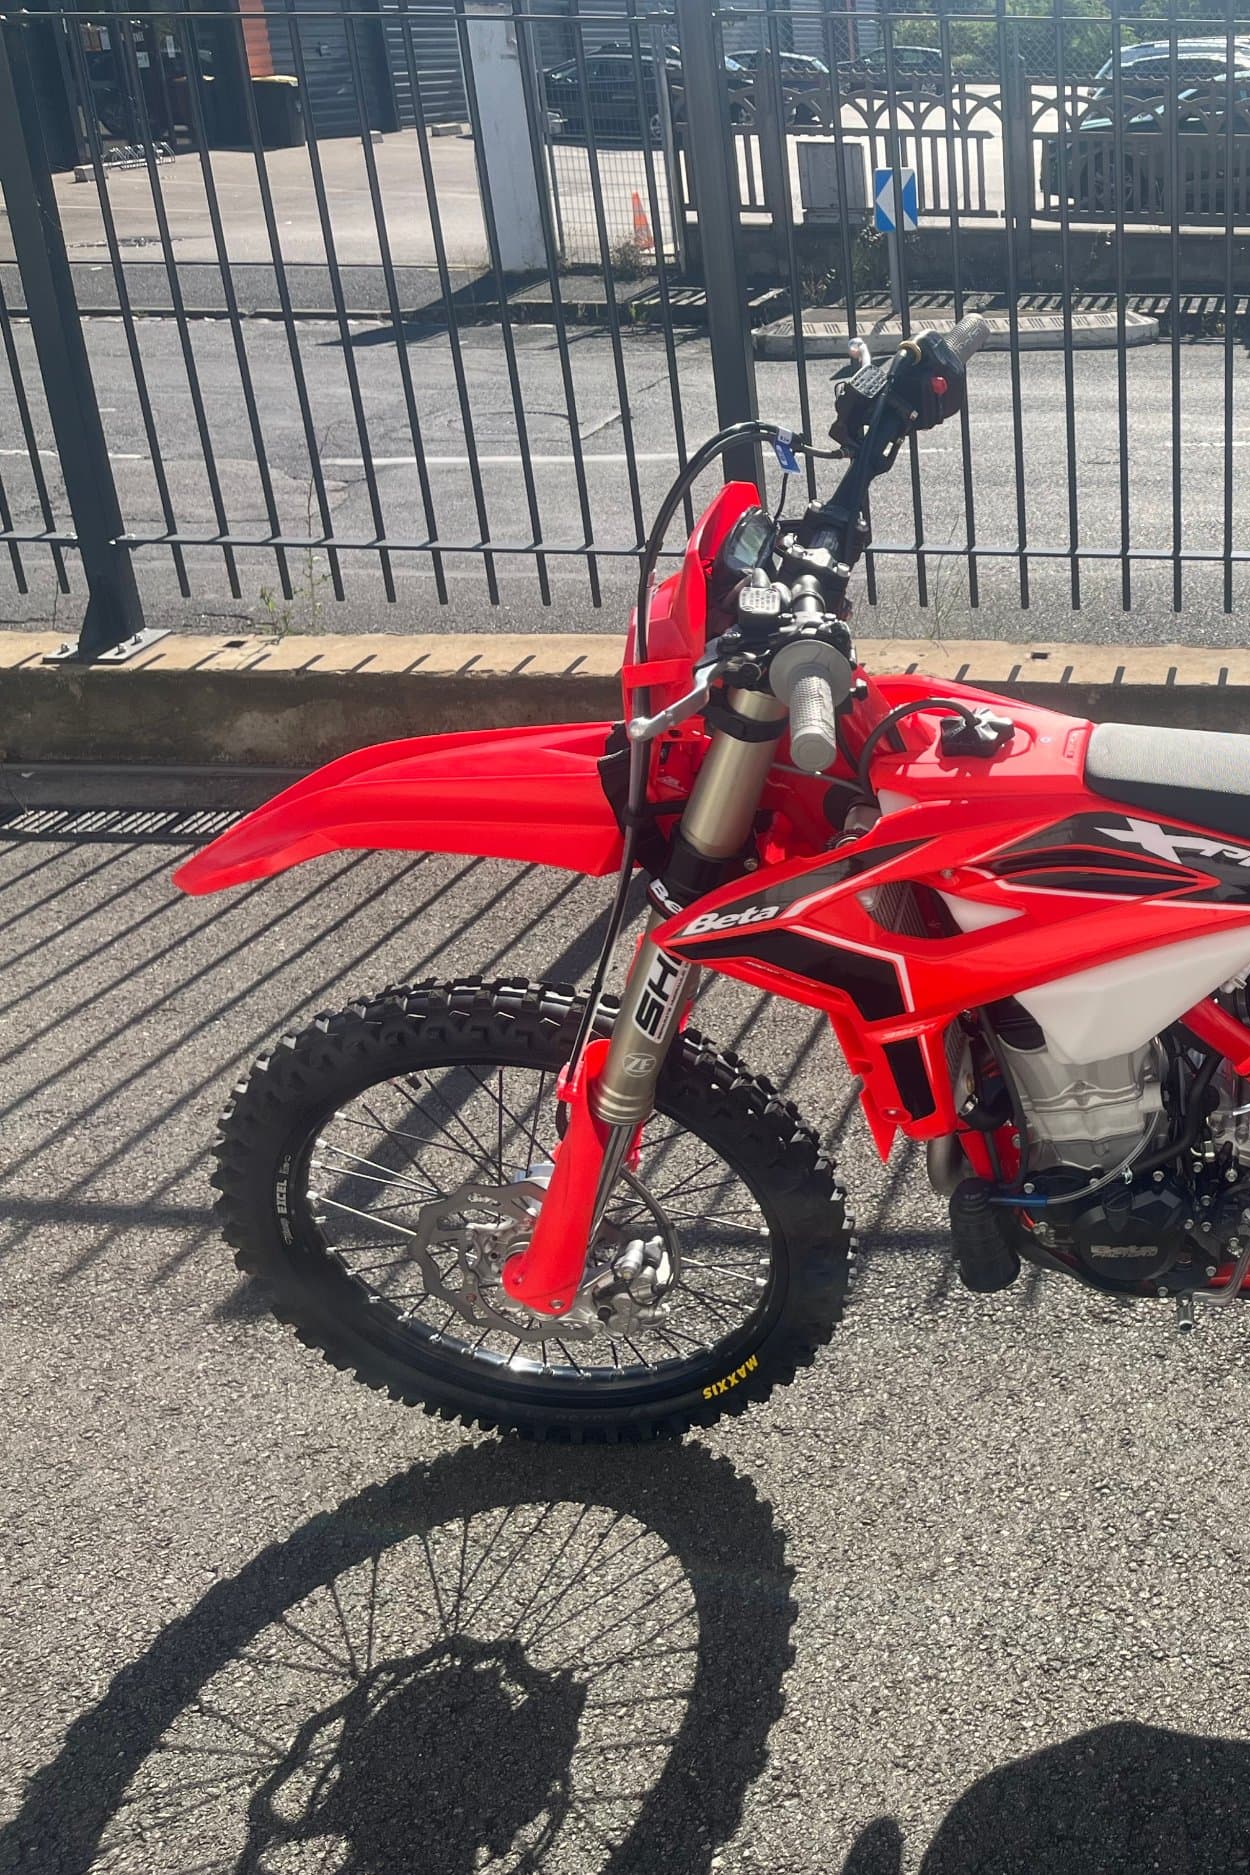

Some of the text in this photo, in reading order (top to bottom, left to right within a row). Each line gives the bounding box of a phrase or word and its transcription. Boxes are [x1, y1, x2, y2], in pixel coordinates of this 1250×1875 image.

[681, 905, 780, 936] Beta
[276, 1179, 288, 1214] EXCEL
[702, 1354, 759, 1400] MAXXIS
